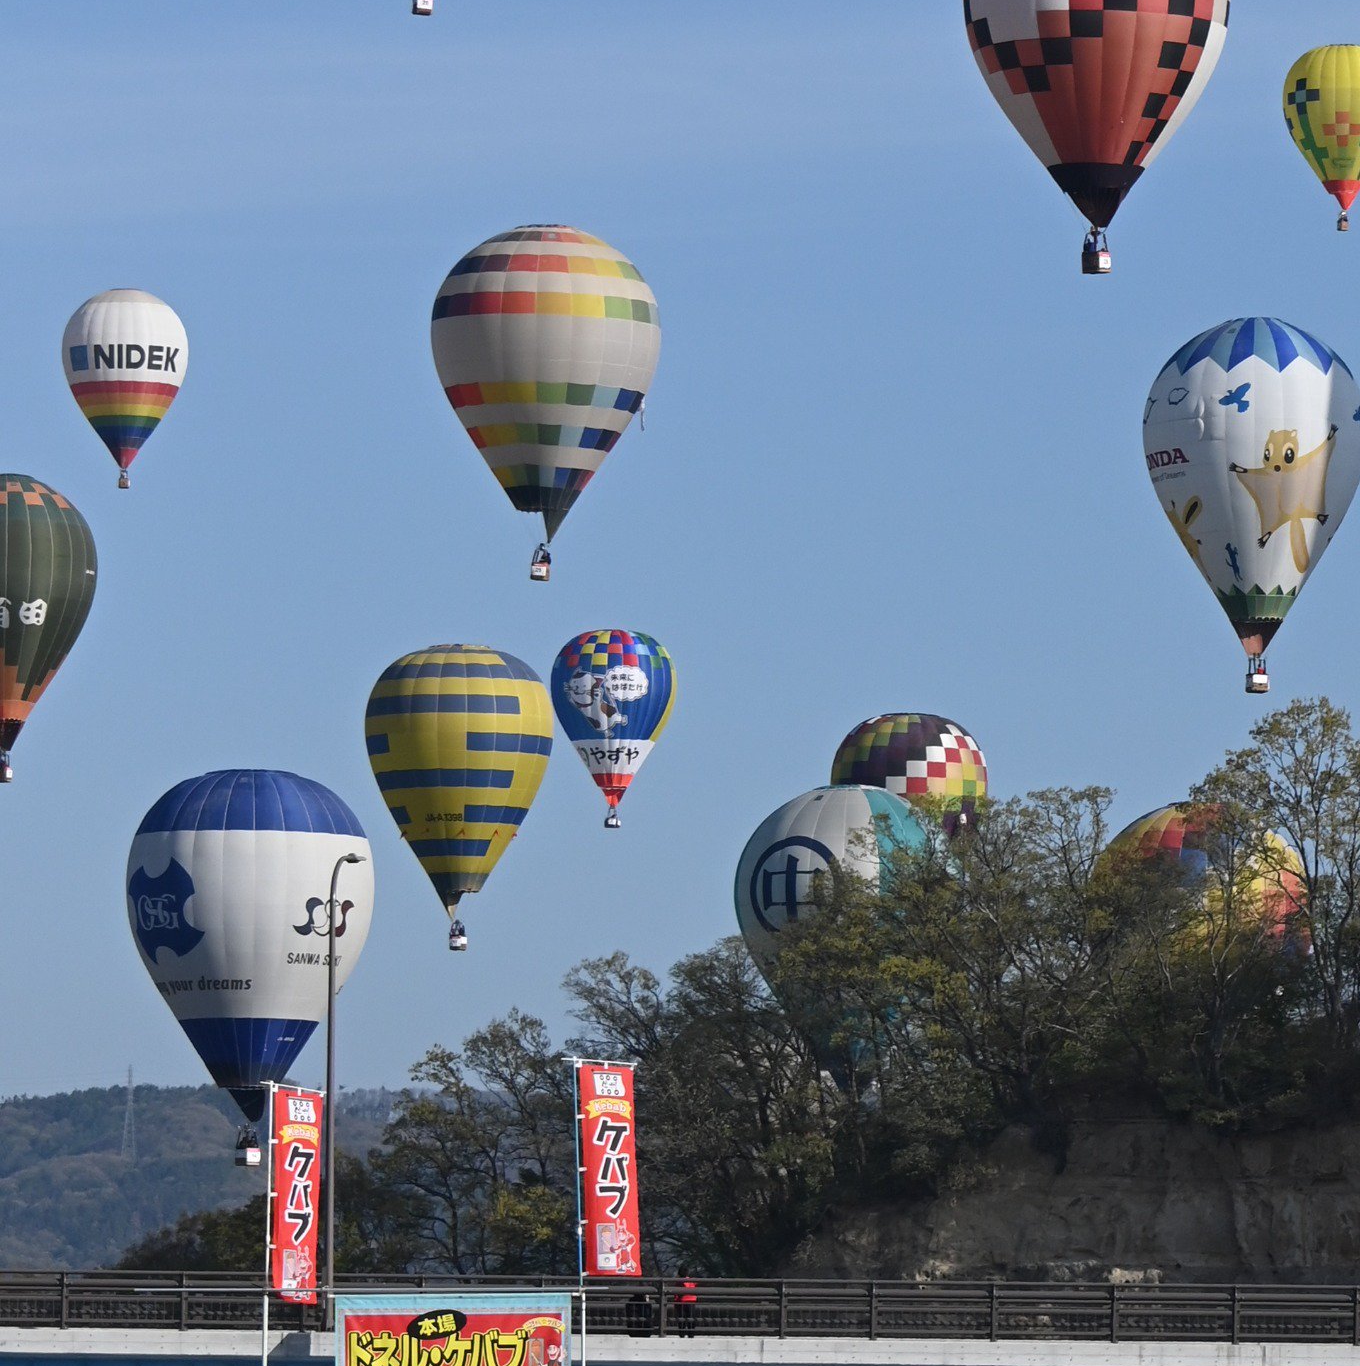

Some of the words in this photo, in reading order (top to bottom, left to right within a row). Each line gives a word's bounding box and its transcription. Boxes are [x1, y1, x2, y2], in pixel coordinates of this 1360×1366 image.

[93, 344, 179, 373] NIDEK
[590, 745, 640, 765] やずや
[286, 952, 320, 966] SANWA
[199, 975, 252, 991] dreams
[595, 1118, 629, 1217] ケバブ
[286, 1143, 316, 1245] ケバブ
[417, 1313, 456, 1336] 本場
